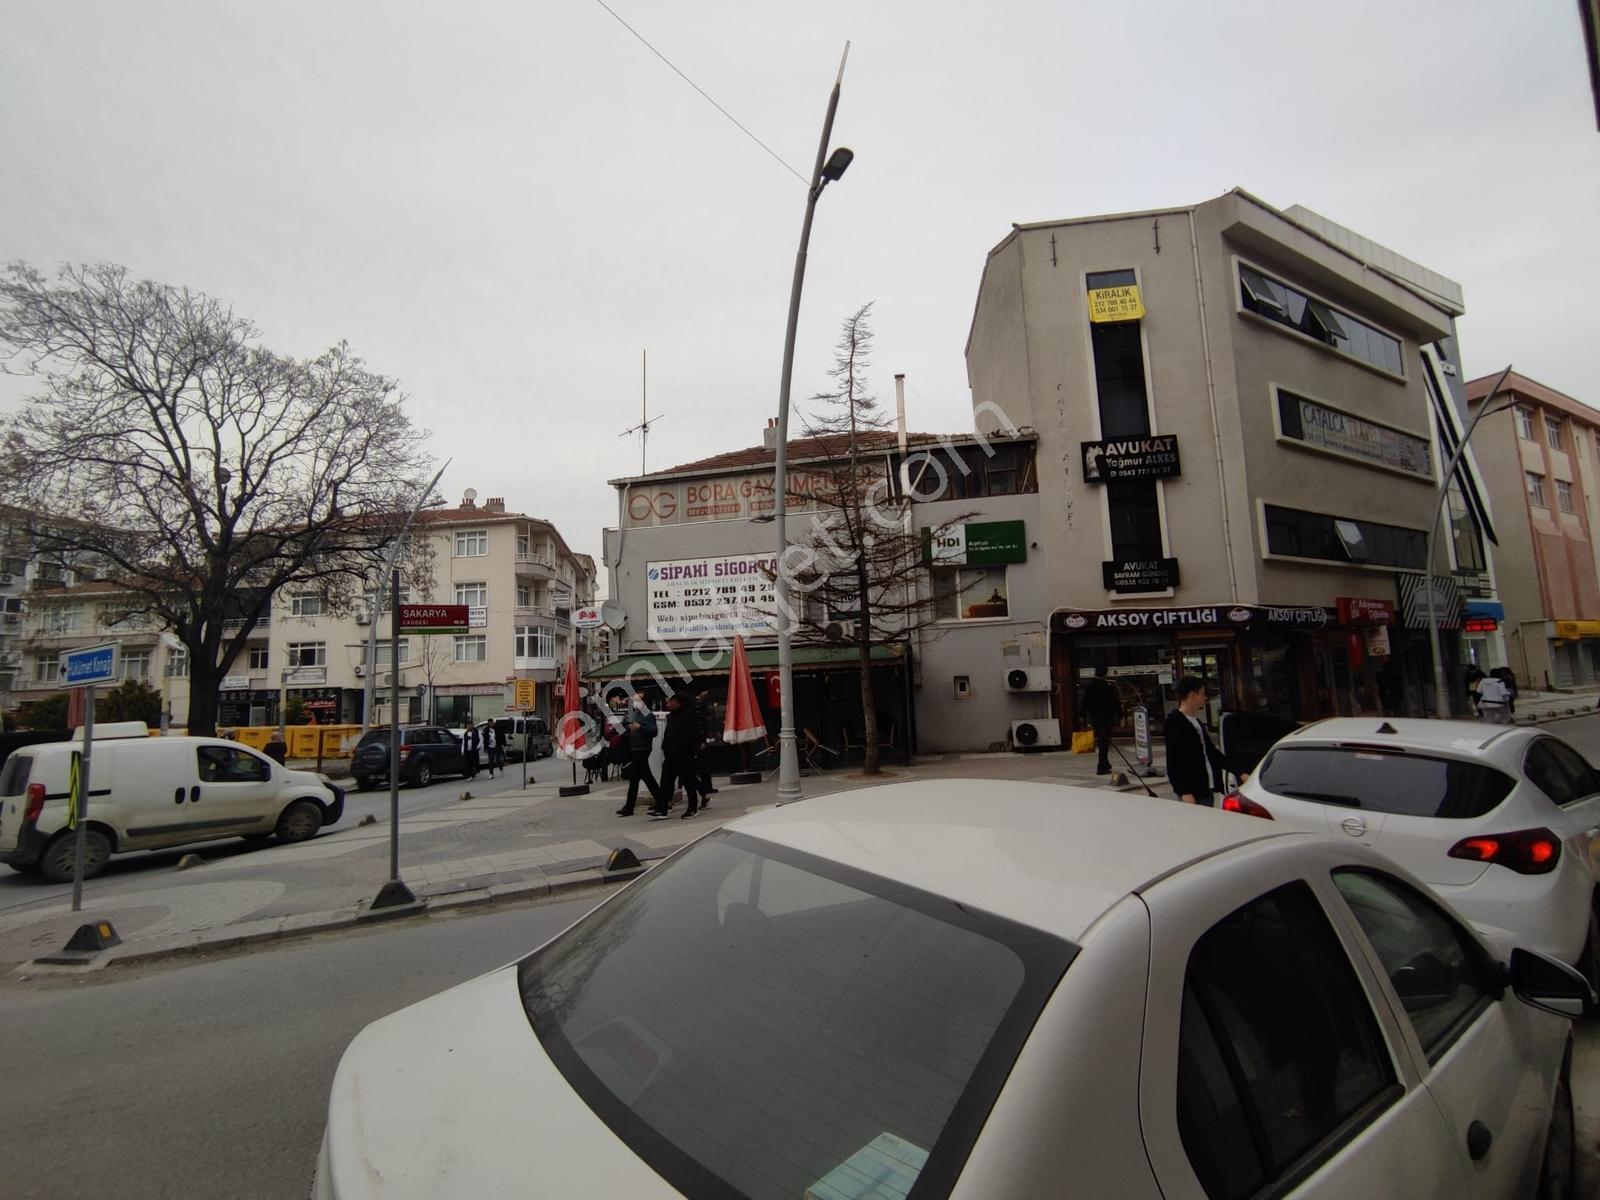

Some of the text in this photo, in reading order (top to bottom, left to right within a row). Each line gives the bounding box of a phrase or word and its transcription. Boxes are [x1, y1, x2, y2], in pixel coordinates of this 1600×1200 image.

[1105, 439, 1173, 456] AVUKAT
[1106, 456, 1143, 468] Yağmur
[687, 482, 736, 504] BORA
[937, 537, 960, 548] HDI
[660, 557, 778, 580] SİPAHİ SİGORTA
[1123, 560, 1159, 571] AVUKAT
[653, 590, 669, 599] TEL
[684, 588, 711, 597] 0212
[684, 598, 712, 607] 0532
[403, 609, 448, 618] SAKARYA
[1096, 608, 1217, 627] AKSOY ÇİFTLİĞİ
